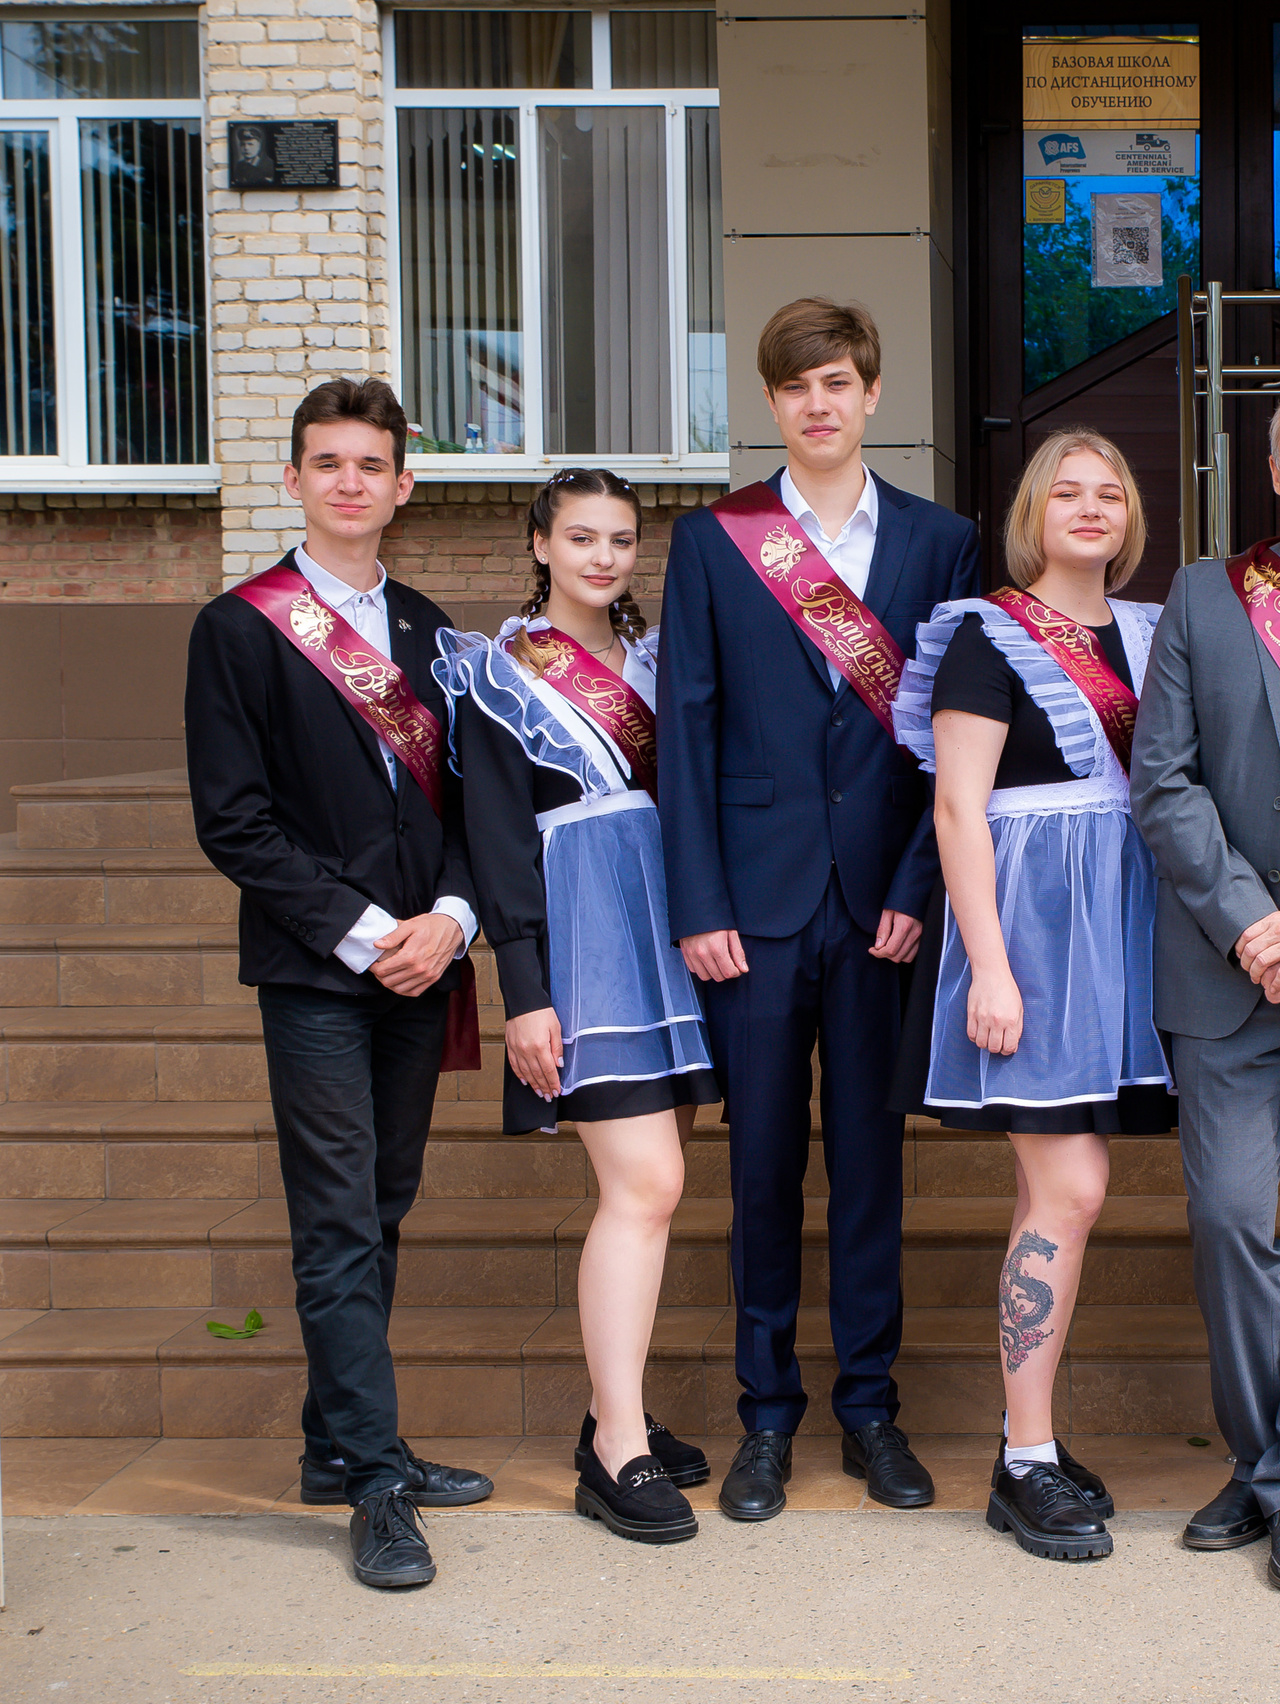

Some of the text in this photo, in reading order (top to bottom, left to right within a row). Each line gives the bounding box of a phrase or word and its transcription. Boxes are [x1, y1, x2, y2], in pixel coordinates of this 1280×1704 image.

[1052, 56, 1171, 68] БАЗОВАЯ ШКОЛА
[1026, 76, 1197, 90] ПО ДИСТАНЦИОННОМУ
[1071, 96, 1152, 108] ОБУЧЕНИЮ
[1060, 142, 1079, 152] AFS
[844, 661, 861, 678] СОШ
[386, 729, 403, 746] СОШ
